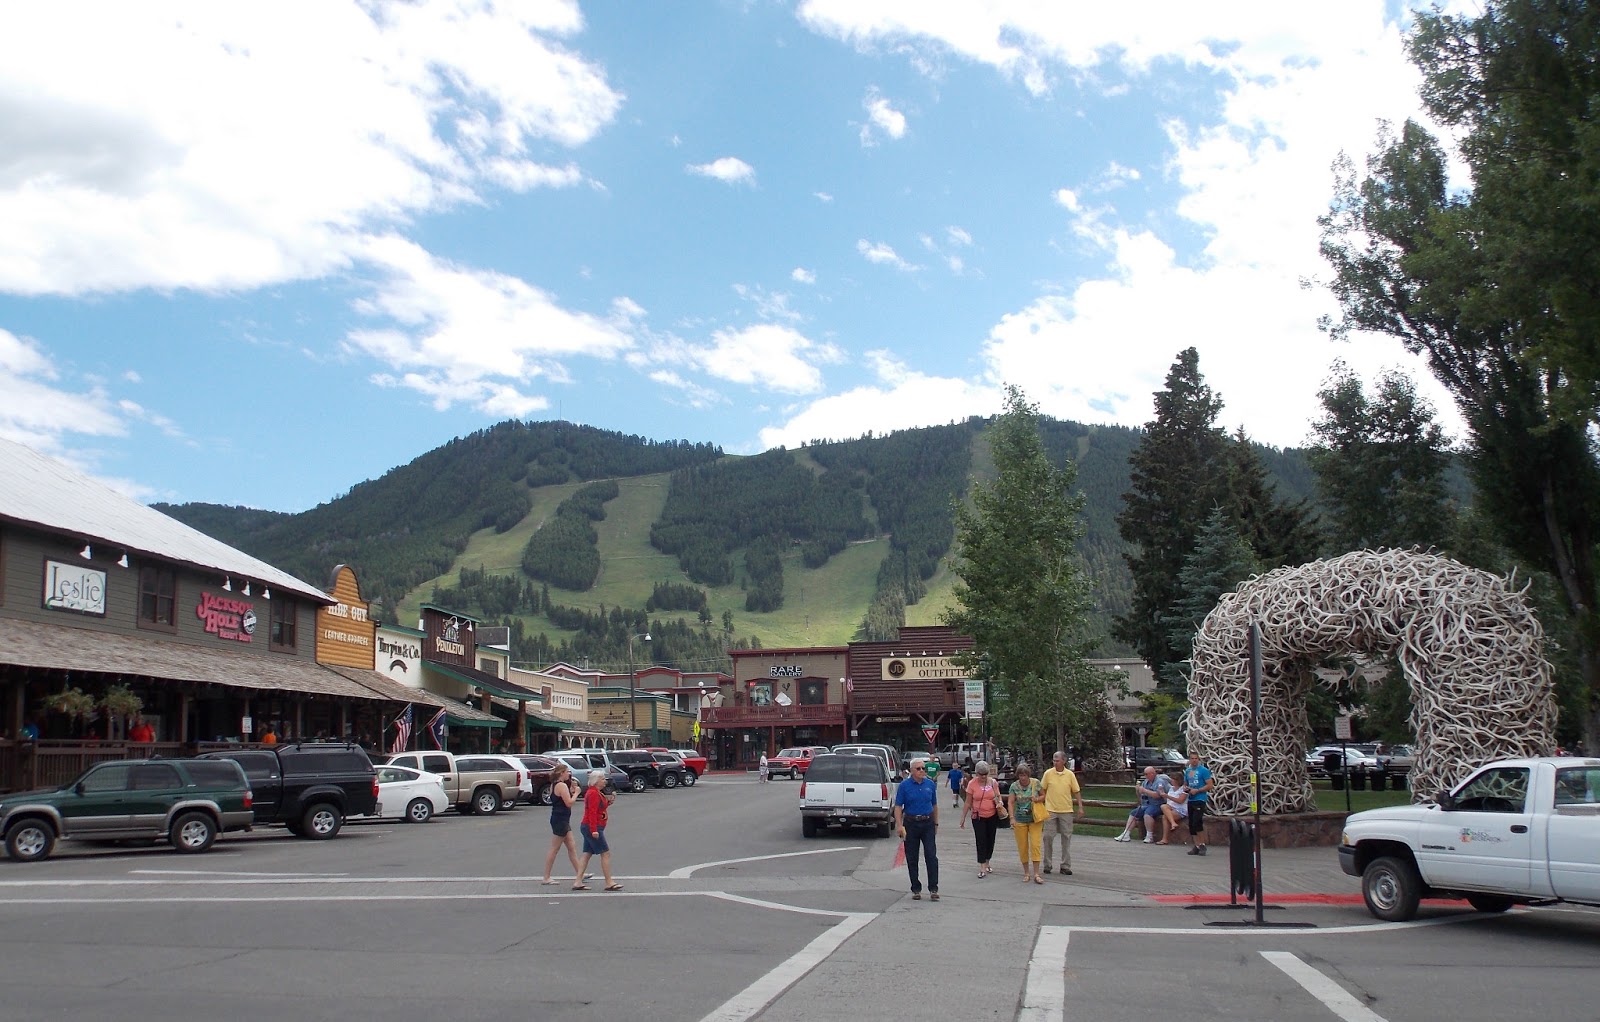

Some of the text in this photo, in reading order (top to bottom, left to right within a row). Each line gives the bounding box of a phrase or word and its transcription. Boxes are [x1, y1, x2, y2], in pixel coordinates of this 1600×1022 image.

[48, 566, 102, 602] Leslie
[196, 592, 254, 619] JACKSON
[327, 603, 368, 622] HIDE OUT
[205, 610, 241, 633] HOLE
[324, 629, 369, 646] LEATHER APPAREL
[378, 636, 402, 659] Turpin
[436, 636, 465, 656] PENDLETON
[911, 659, 937, 668] HIGH
[552, 694, 581, 707] OUTFITTERS
